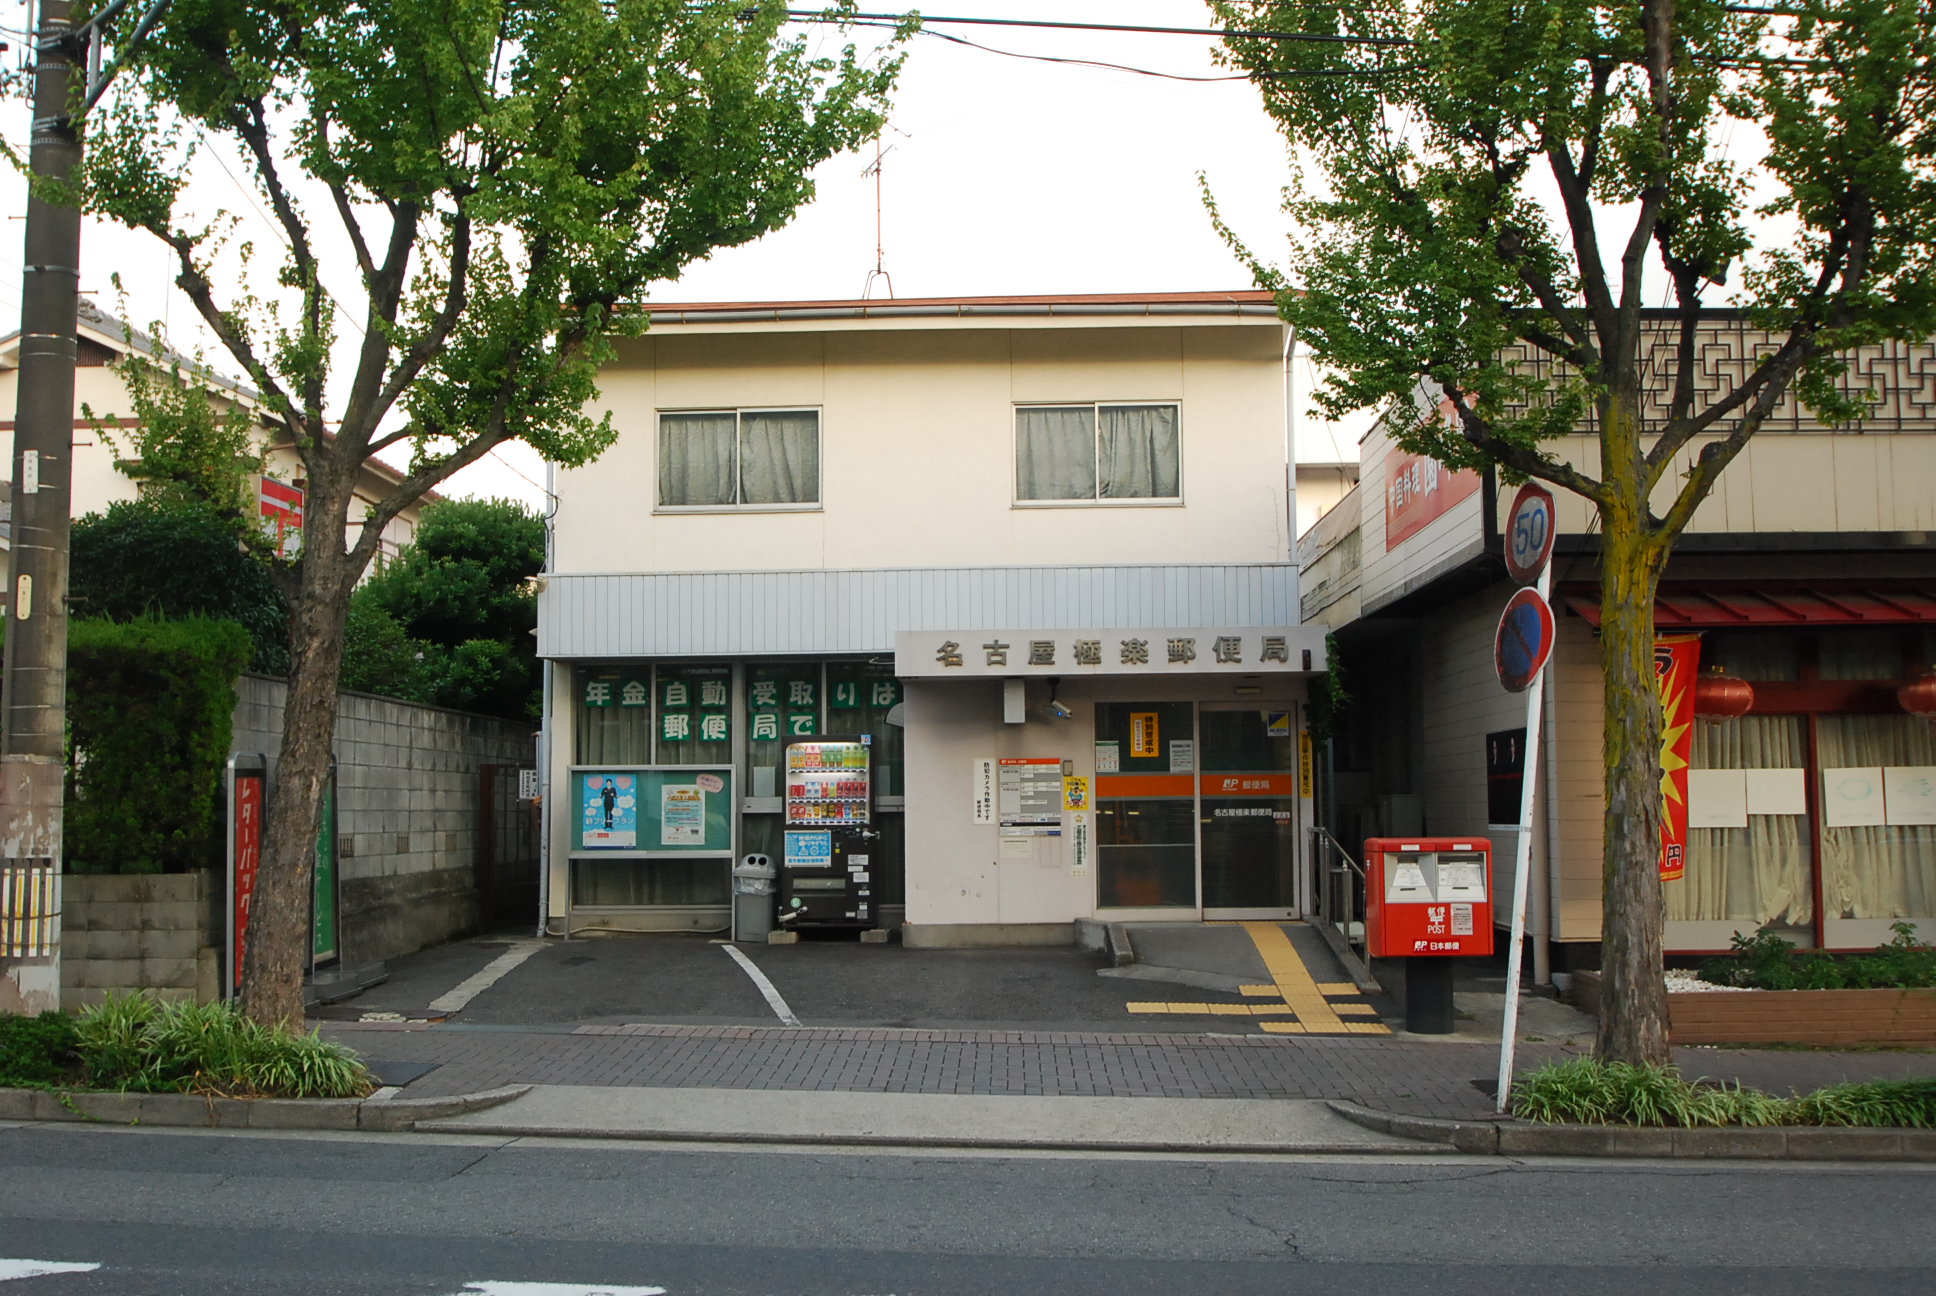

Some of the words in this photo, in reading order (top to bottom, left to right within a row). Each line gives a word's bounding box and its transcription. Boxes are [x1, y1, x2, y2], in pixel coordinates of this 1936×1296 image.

[1389, 461, 1421, 517] 中国料理
[1516, 507, 1545, 556] 50
[936, 635, 1290, 668] 名古屋極楽郵便局
[585, 680, 897, 706] 年金自動受取りは
[662, 713, 815, 740] 郵便局で
[983, 762, 991, 821] 防犯カメラ作動中です
[1242, 780, 1270, 790] 郵便局
[1214, 808, 1273, 817] 名古屋極楽郵便局
[1665, 843, 1681, 867] 円
[1427, 906, 1446, 917] 郵便
[1427, 925, 1446, 934] POST
[1430, 942, 1460, 950] 日本郵便
